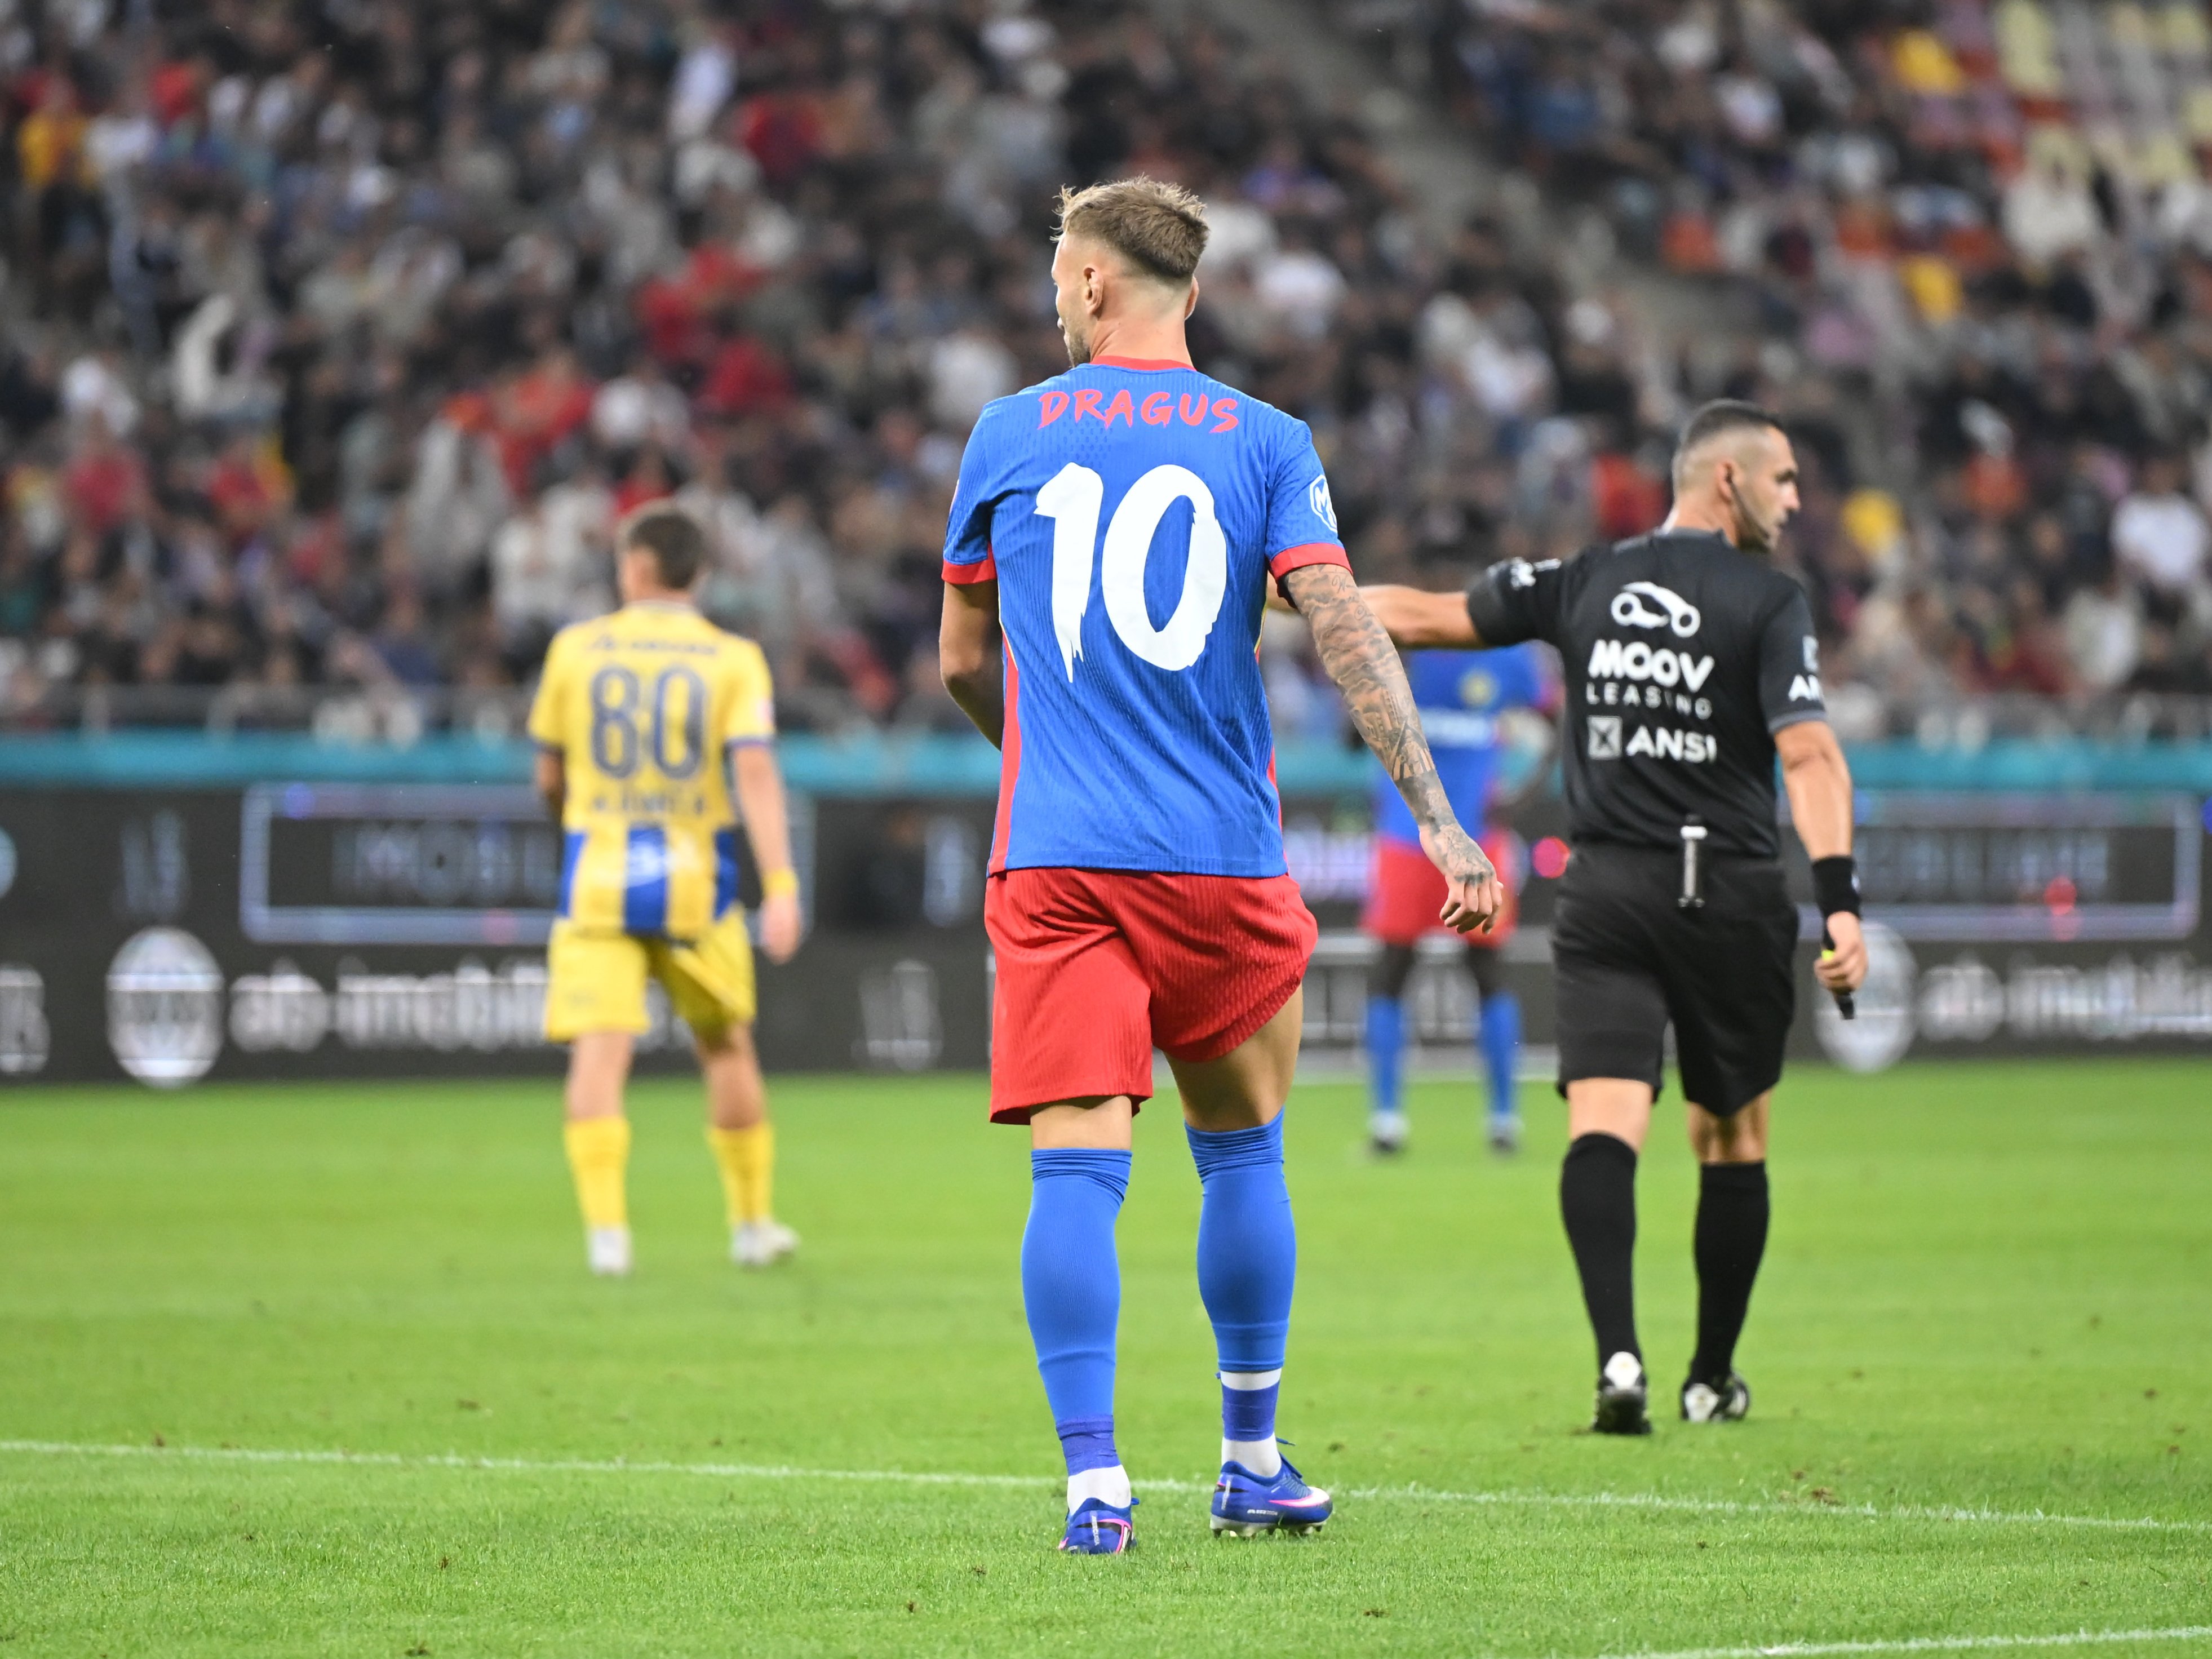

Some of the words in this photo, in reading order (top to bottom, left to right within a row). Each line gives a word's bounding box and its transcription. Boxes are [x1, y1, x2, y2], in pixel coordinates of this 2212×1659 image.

[1037, 388, 1239, 434] DRAGUS
[1033, 462, 1226, 683] 10
[1588, 639, 1714, 693] MOOV
[589, 663, 708, 780] 80
[1586, 682, 1713, 720] LEASING
[1625, 724, 1717, 764] ANSI
